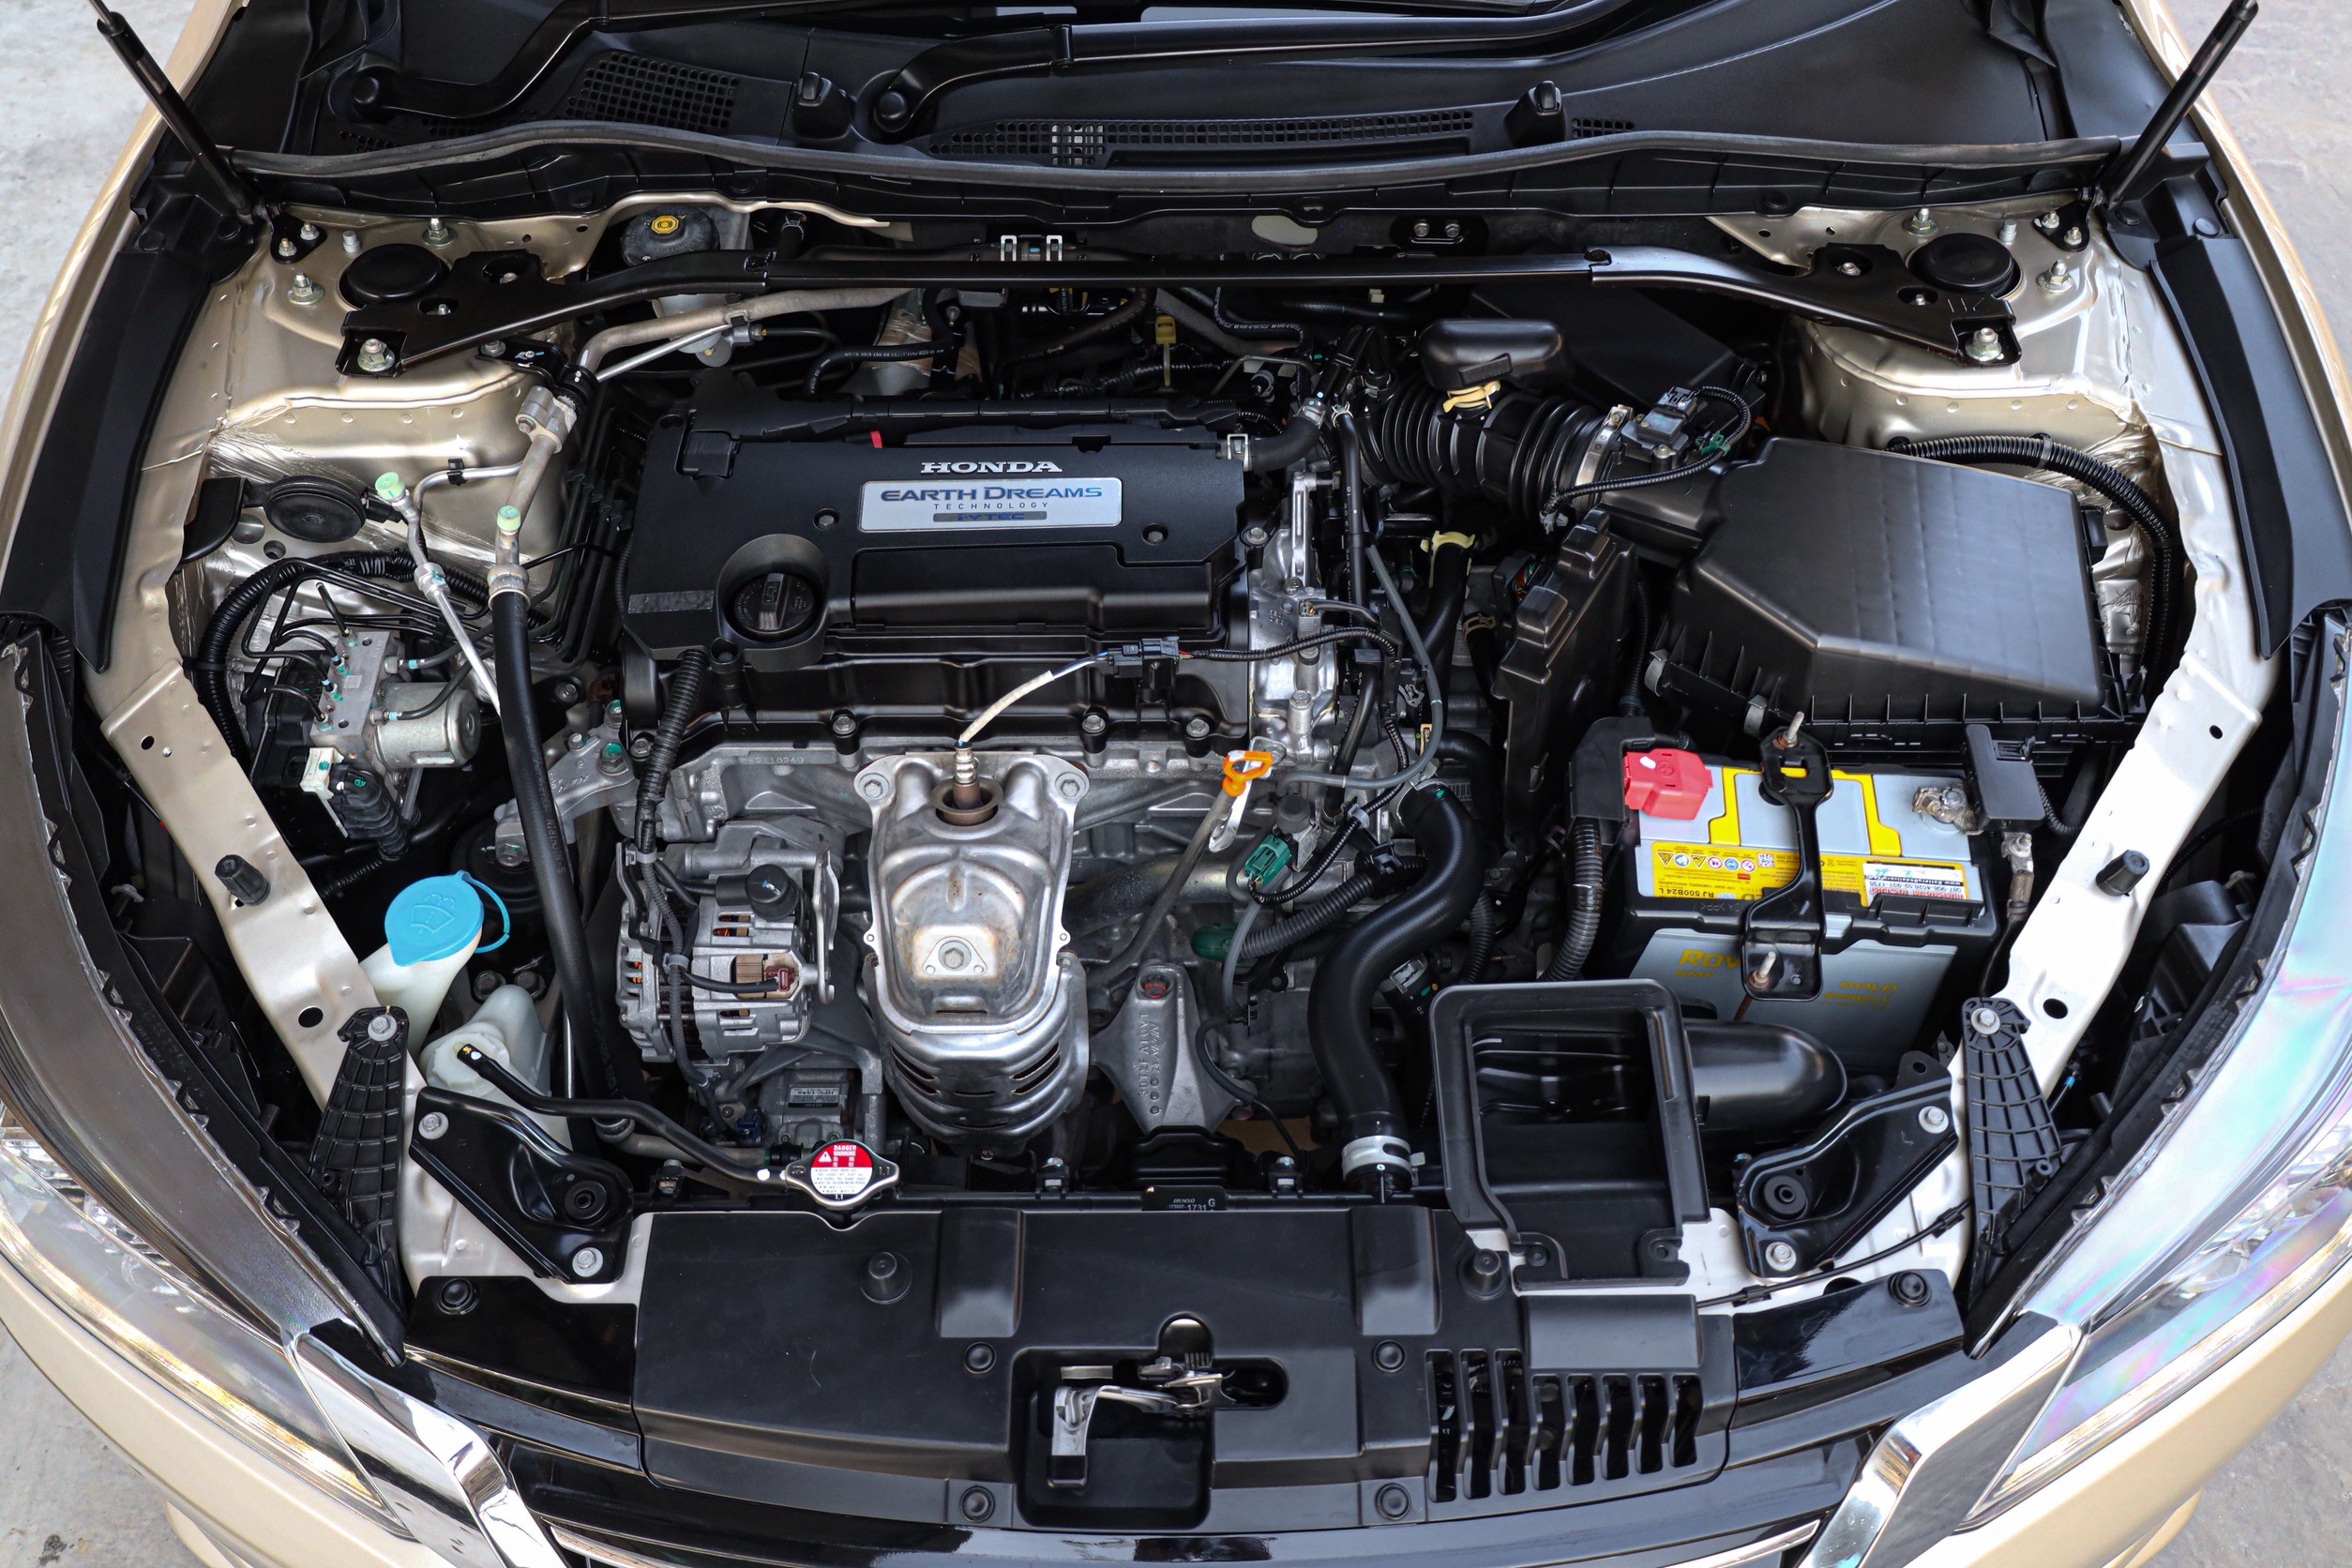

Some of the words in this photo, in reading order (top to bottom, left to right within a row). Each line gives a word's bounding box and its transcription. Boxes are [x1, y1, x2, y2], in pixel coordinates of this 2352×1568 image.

[920, 460, 1063, 475] HONDA
[881, 489, 977, 501] EARTH
[984, 486, 1103, 500] DREAMS
[934, 502, 1049, 510] TECHNOLOGY
[1666, 888, 1700, 897] 500B24
[1839, 980, 1899, 992] GOLD
[879, 1166, 890, 1176] 1.1
[1208, 1198, 1216, 1208] G
